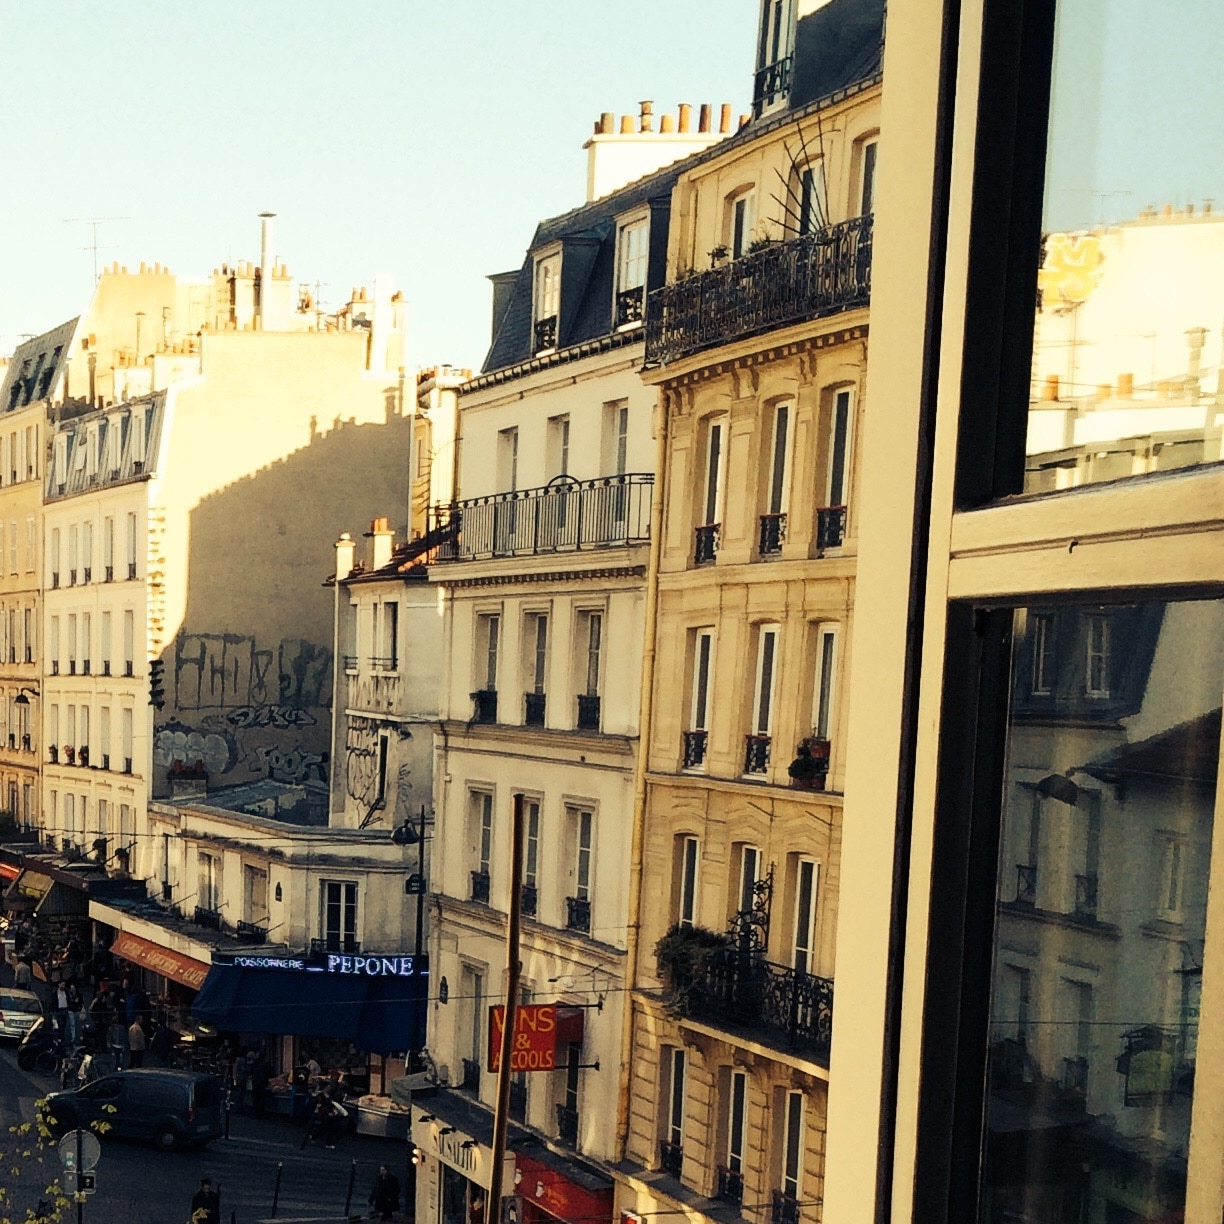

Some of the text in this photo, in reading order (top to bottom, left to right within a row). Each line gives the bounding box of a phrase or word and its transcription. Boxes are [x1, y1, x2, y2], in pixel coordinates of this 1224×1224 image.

[234, 954, 414, 976] POISSONNERIE PEPONE
[493, 1007, 556, 1033] VNS
[516, 1033, 531, 1049] &
[493, 1050, 554, 1069] ACOOLS
